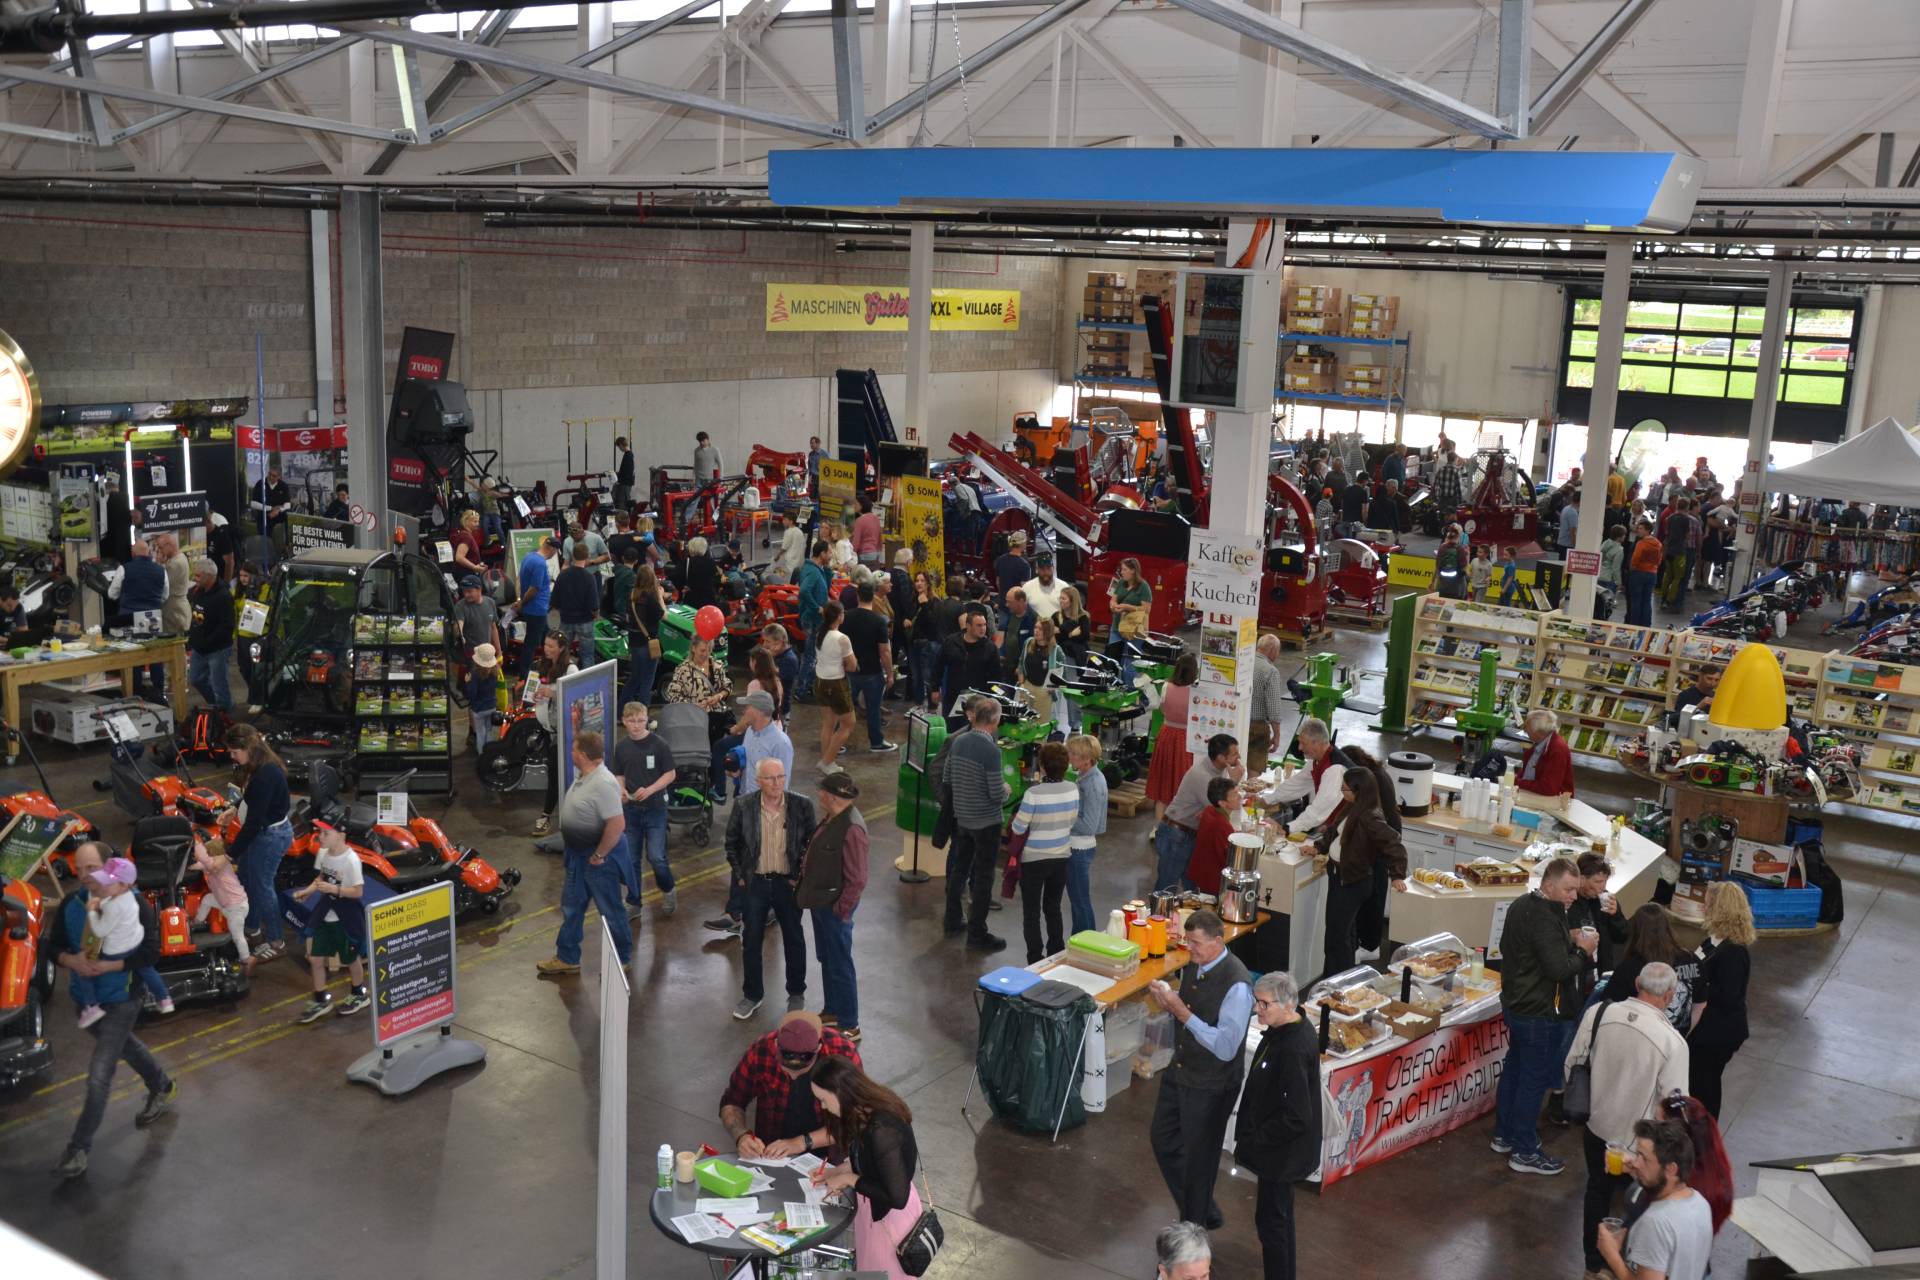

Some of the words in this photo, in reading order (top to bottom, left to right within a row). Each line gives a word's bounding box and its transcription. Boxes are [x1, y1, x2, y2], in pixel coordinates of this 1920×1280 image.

[791, 300, 860, 315] MASCHINEN
[410, 360, 438, 373] TORO
[394, 463, 422, 475] TORO
[833, 470, 854, 479] SOMA
[917, 488, 939, 497] SOMA
[161, 501, 199, 510] SEGWAY
[292, 524, 303, 534] DIE
[304, 526, 324, 538] BESTE
[324, 529, 344, 541] WAHL
[292, 535, 305, 545] FÜR
[306, 537, 319, 548] DEN
[1198, 543, 1254, 567] Kaffee
[1191, 581, 1257, 606] Kuchen
[406, 898, 428, 912] DASS
[375, 922, 386, 933] DU
[387, 916, 405, 929] HIER
[405, 910, 425, 925] BIST!
[387, 935, 403, 947] Haus
[403, 934, 409, 942] &
[408, 928, 429, 940] Garten
[401, 940, 412, 951] dich
[400, 964, 422, 976] kreative
[423, 953, 449, 968] Aussteller
[390, 977, 428, 995] Verköstigung
[1385, 1020, 1510, 1092] OBERGAILTALER
[1373, 1058, 1506, 1137] TRACHTENGRUP
